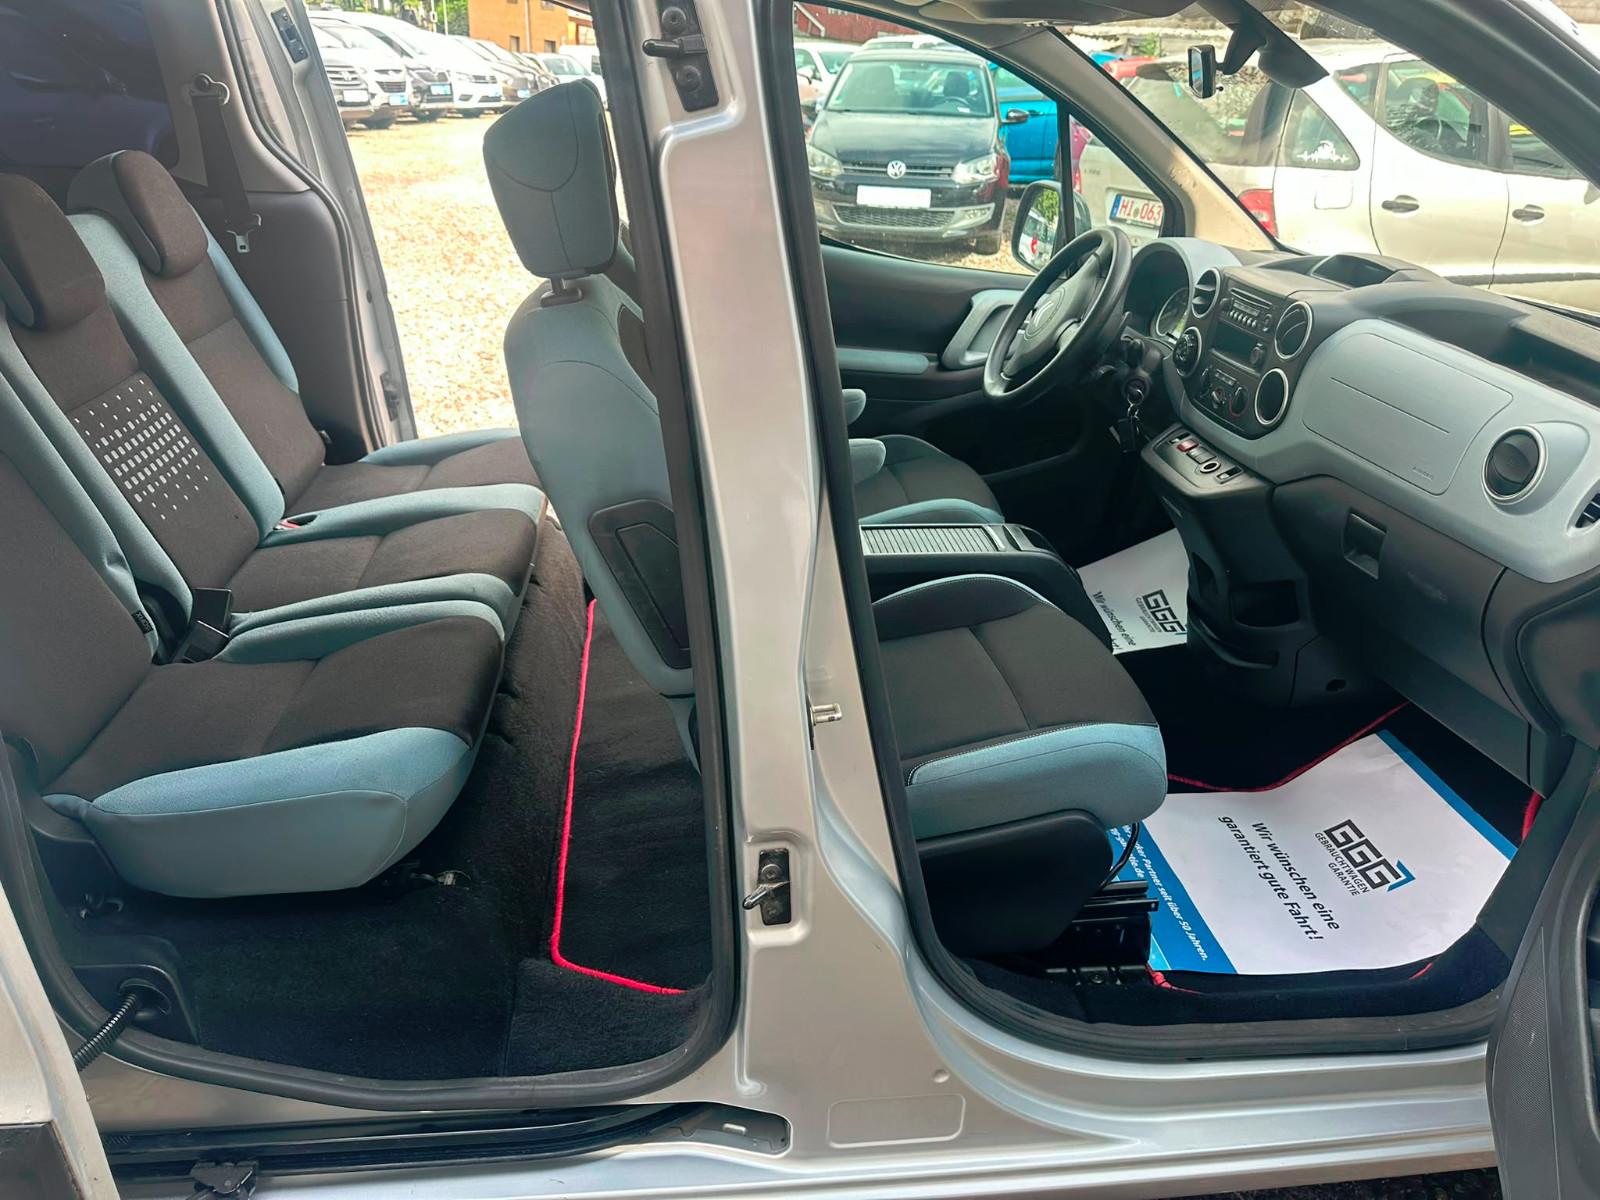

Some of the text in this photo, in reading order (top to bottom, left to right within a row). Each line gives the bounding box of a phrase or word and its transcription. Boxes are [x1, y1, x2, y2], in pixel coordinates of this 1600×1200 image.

[1142, 589, 1186, 632] GGG
[1217, 816, 1324, 940] garantiert gute Fahrt!
[1251, 822, 1340, 930] Wir wünschen eine
[1314, 831, 1370, 894] GEBRAUCHTWAGEN
[1323, 818, 1402, 890] GGG
[1328, 862, 1360, 897] GARANTIE
[1142, 858, 1162, 887] Partner
[1158, 887, 1172, 902] seit
[1167, 901, 1184, 921] über
[1178, 920, 1192, 931] 50
[1185, 930, 1208, 961] Jahren.
